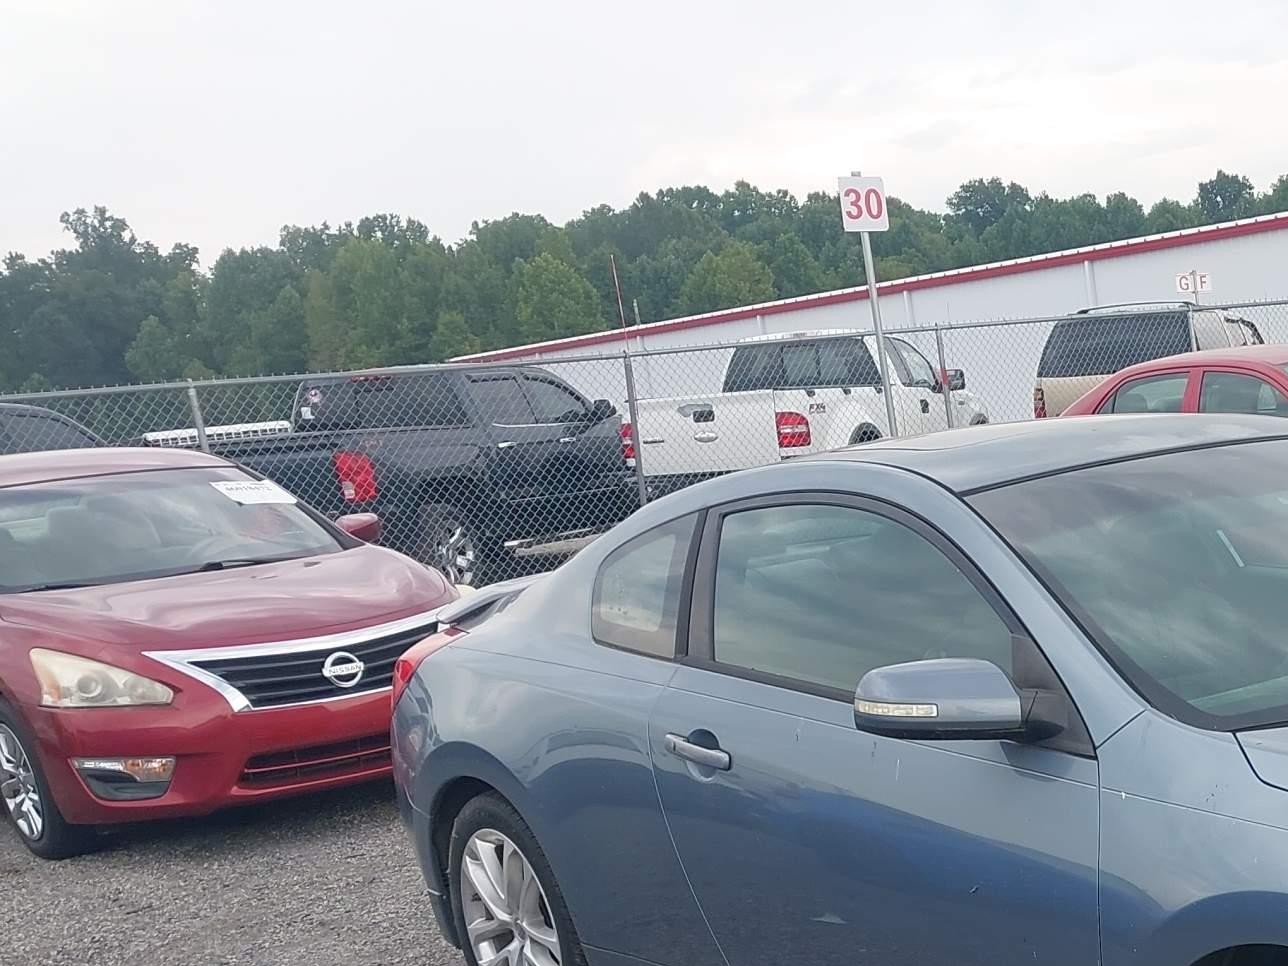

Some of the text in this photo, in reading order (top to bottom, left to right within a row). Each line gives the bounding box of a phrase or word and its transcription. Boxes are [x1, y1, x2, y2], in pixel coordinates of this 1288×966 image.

[844, 188, 883, 220] 30
[1179, 275, 1190, 291] G
[1199, 274, 1207, 290] F
[809, 402, 826, 412] FX4
